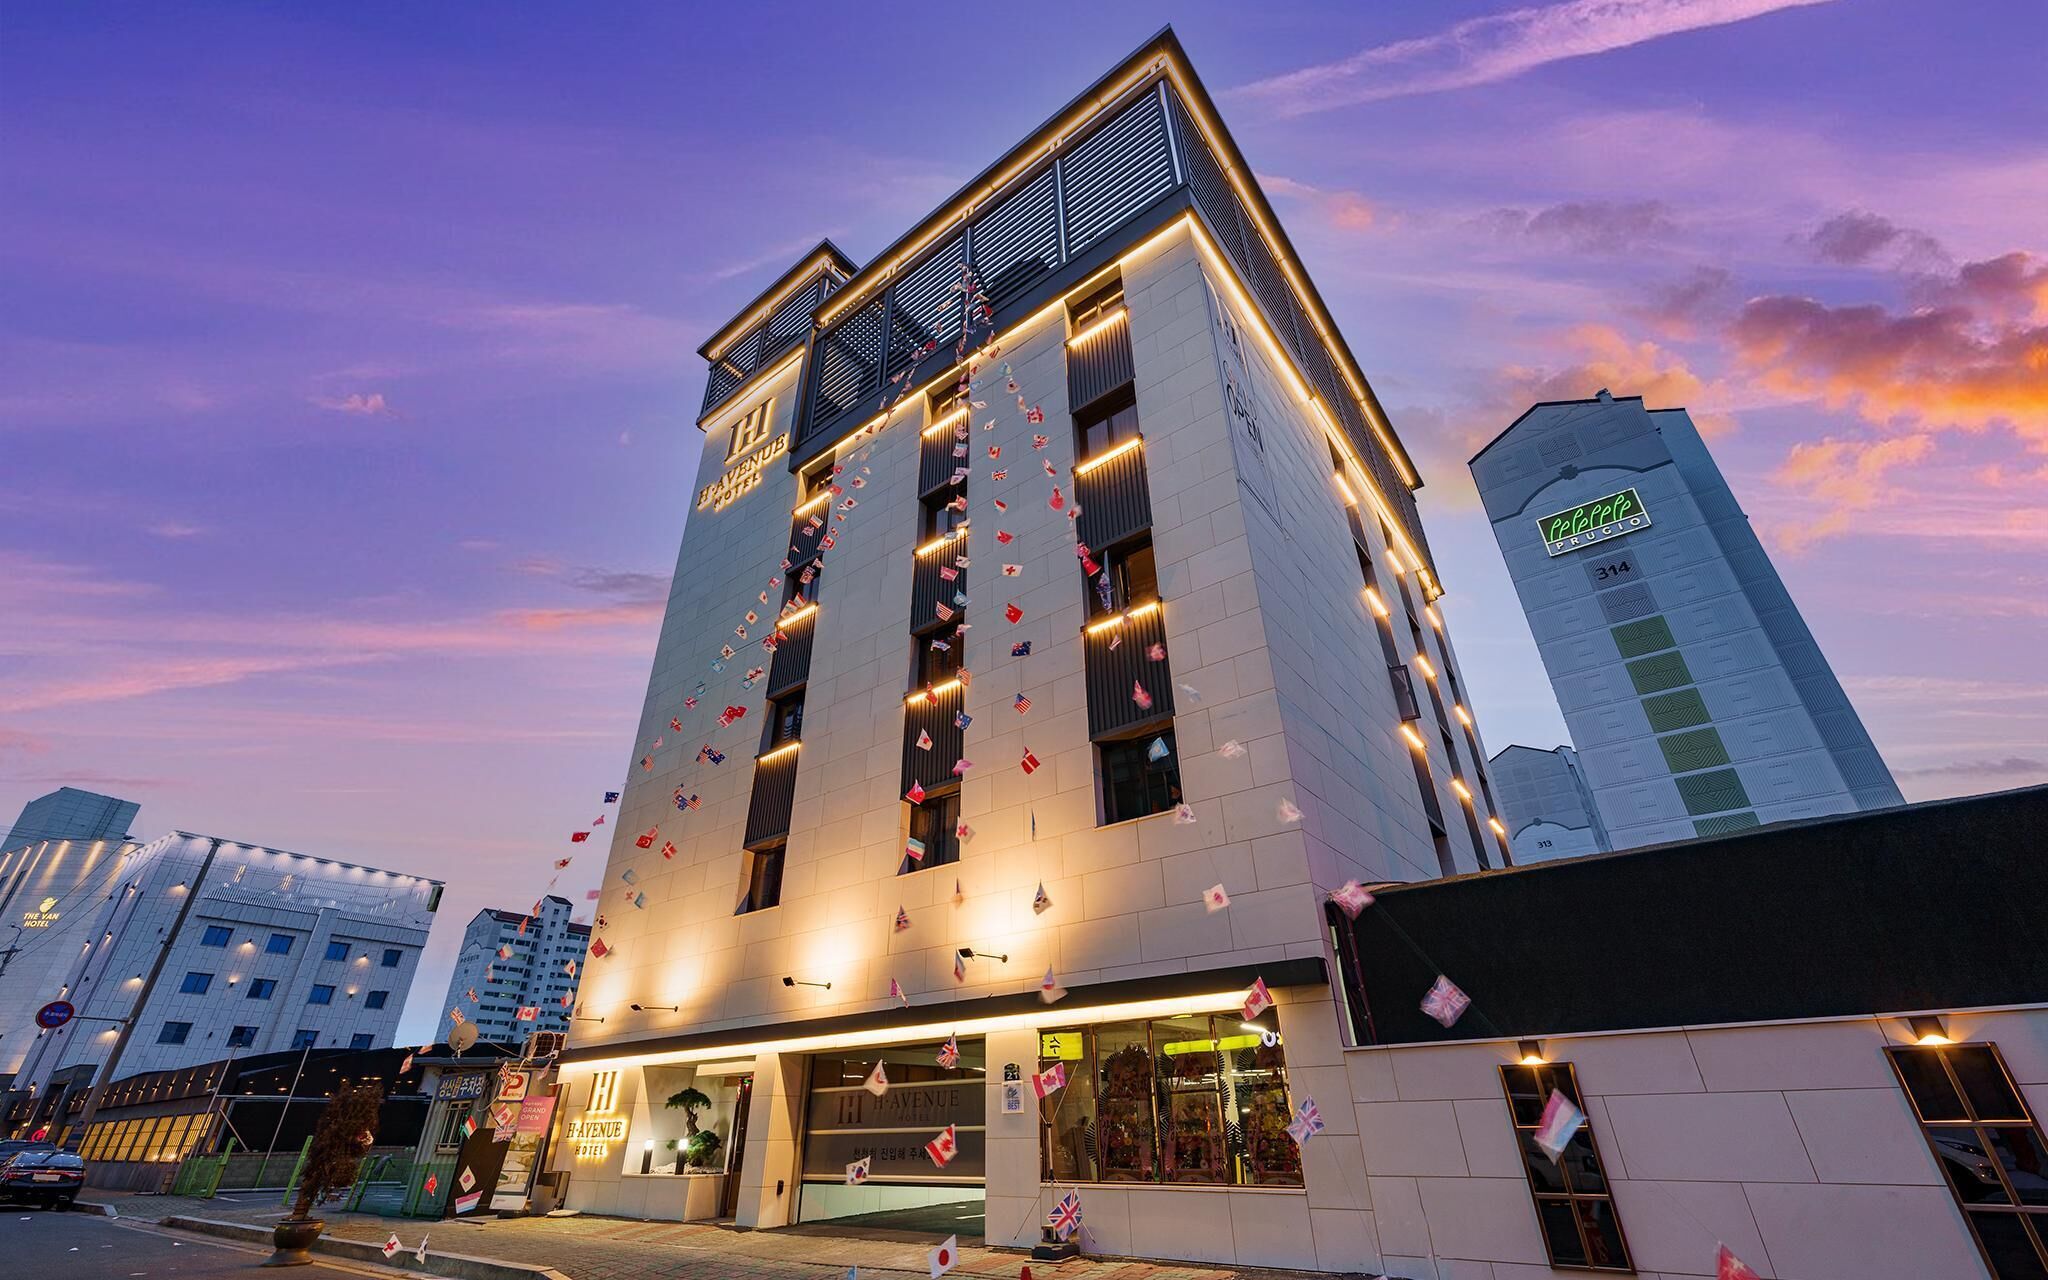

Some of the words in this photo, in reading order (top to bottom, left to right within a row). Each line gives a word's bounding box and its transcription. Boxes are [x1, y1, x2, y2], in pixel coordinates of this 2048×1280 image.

[714, 473, 759, 508] HOTEL
[1556, 517, 1641, 550] PRUGIO
[1595, 561, 1631, 580] 314
[1537, 840, 1552, 848] 313
[23, 912, 39, 920] THE
[23, 920, 49, 928] HOTEL
[1006, 1072, 1018, 1080] 21
[460, 1076, 485, 1096] 주차장
[575, 1145, 603, 1155] HOTEL
[881, 1147, 906, 1160] 진입해
[909, 1147, 931, 1160] 주세
